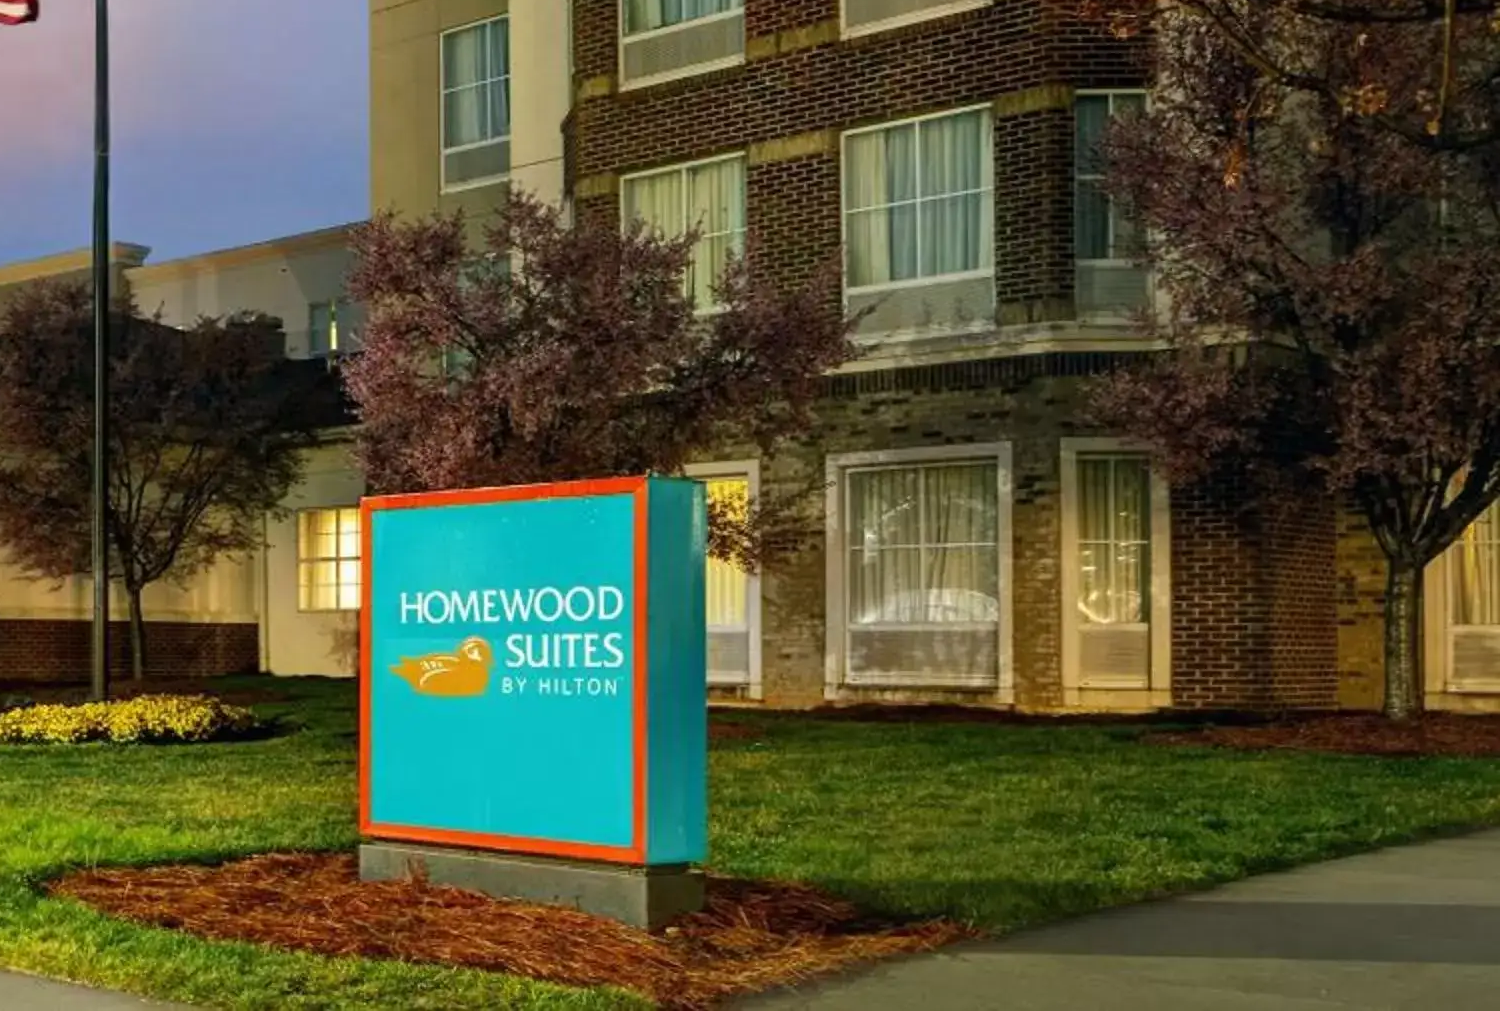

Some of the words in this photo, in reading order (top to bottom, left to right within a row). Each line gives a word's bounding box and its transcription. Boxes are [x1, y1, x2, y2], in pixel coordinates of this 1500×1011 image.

[400, 586, 624, 624] HOMEWOOD
[505, 633, 624, 668] SUITES
[501, 676, 526, 694] BY
[539, 677, 618, 696] HILTON
